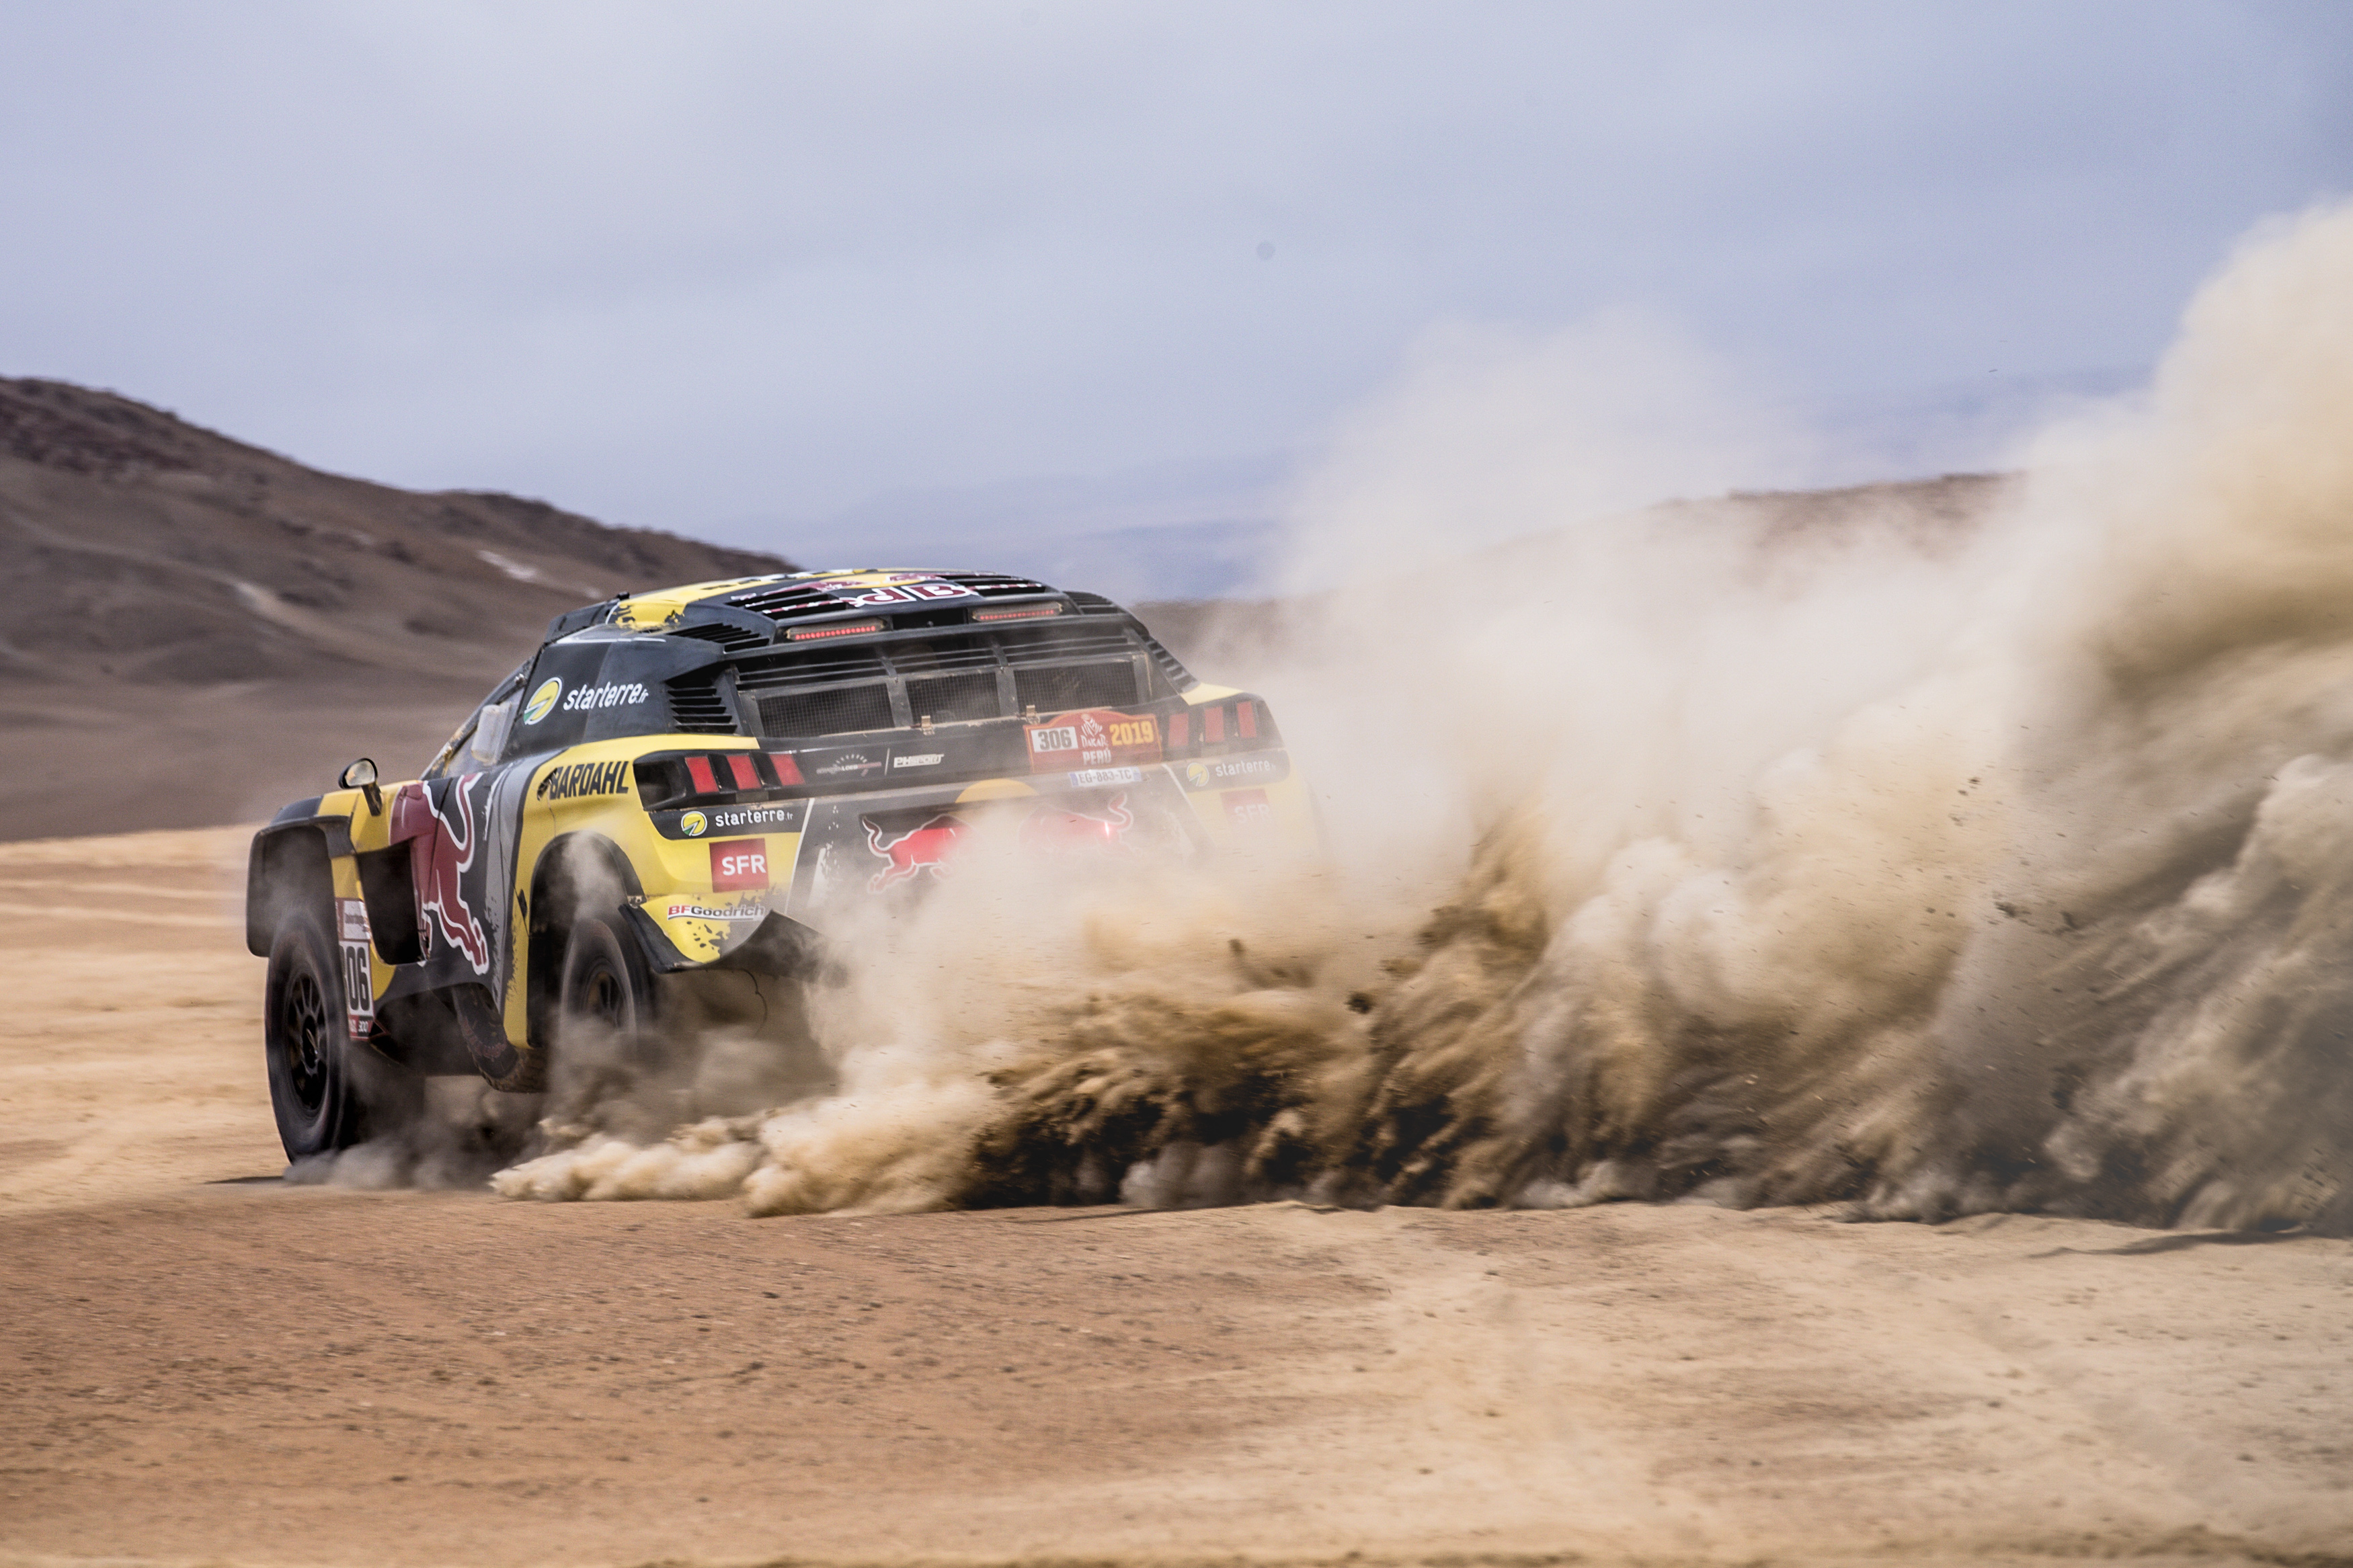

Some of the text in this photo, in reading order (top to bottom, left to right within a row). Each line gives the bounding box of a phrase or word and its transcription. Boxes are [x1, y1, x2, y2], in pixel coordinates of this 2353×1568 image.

[563, 681, 649, 710] starterre.fr
[1038, 729, 1072, 750] 306
[1080, 733, 1109, 748] DAKAR
[1109, 720, 1154, 746] 2019
[549, 761, 629, 800] BARDAHL
[1078, 769, 1133, 784] EG-883-TC
[715, 809, 794, 827] starterre.fr
[1234, 803, 1271, 824] SFR
[721, 854, 767, 876] SFR
[668, 903, 765, 917] BFGoodrich
[339, 945, 370, 1011] 06
